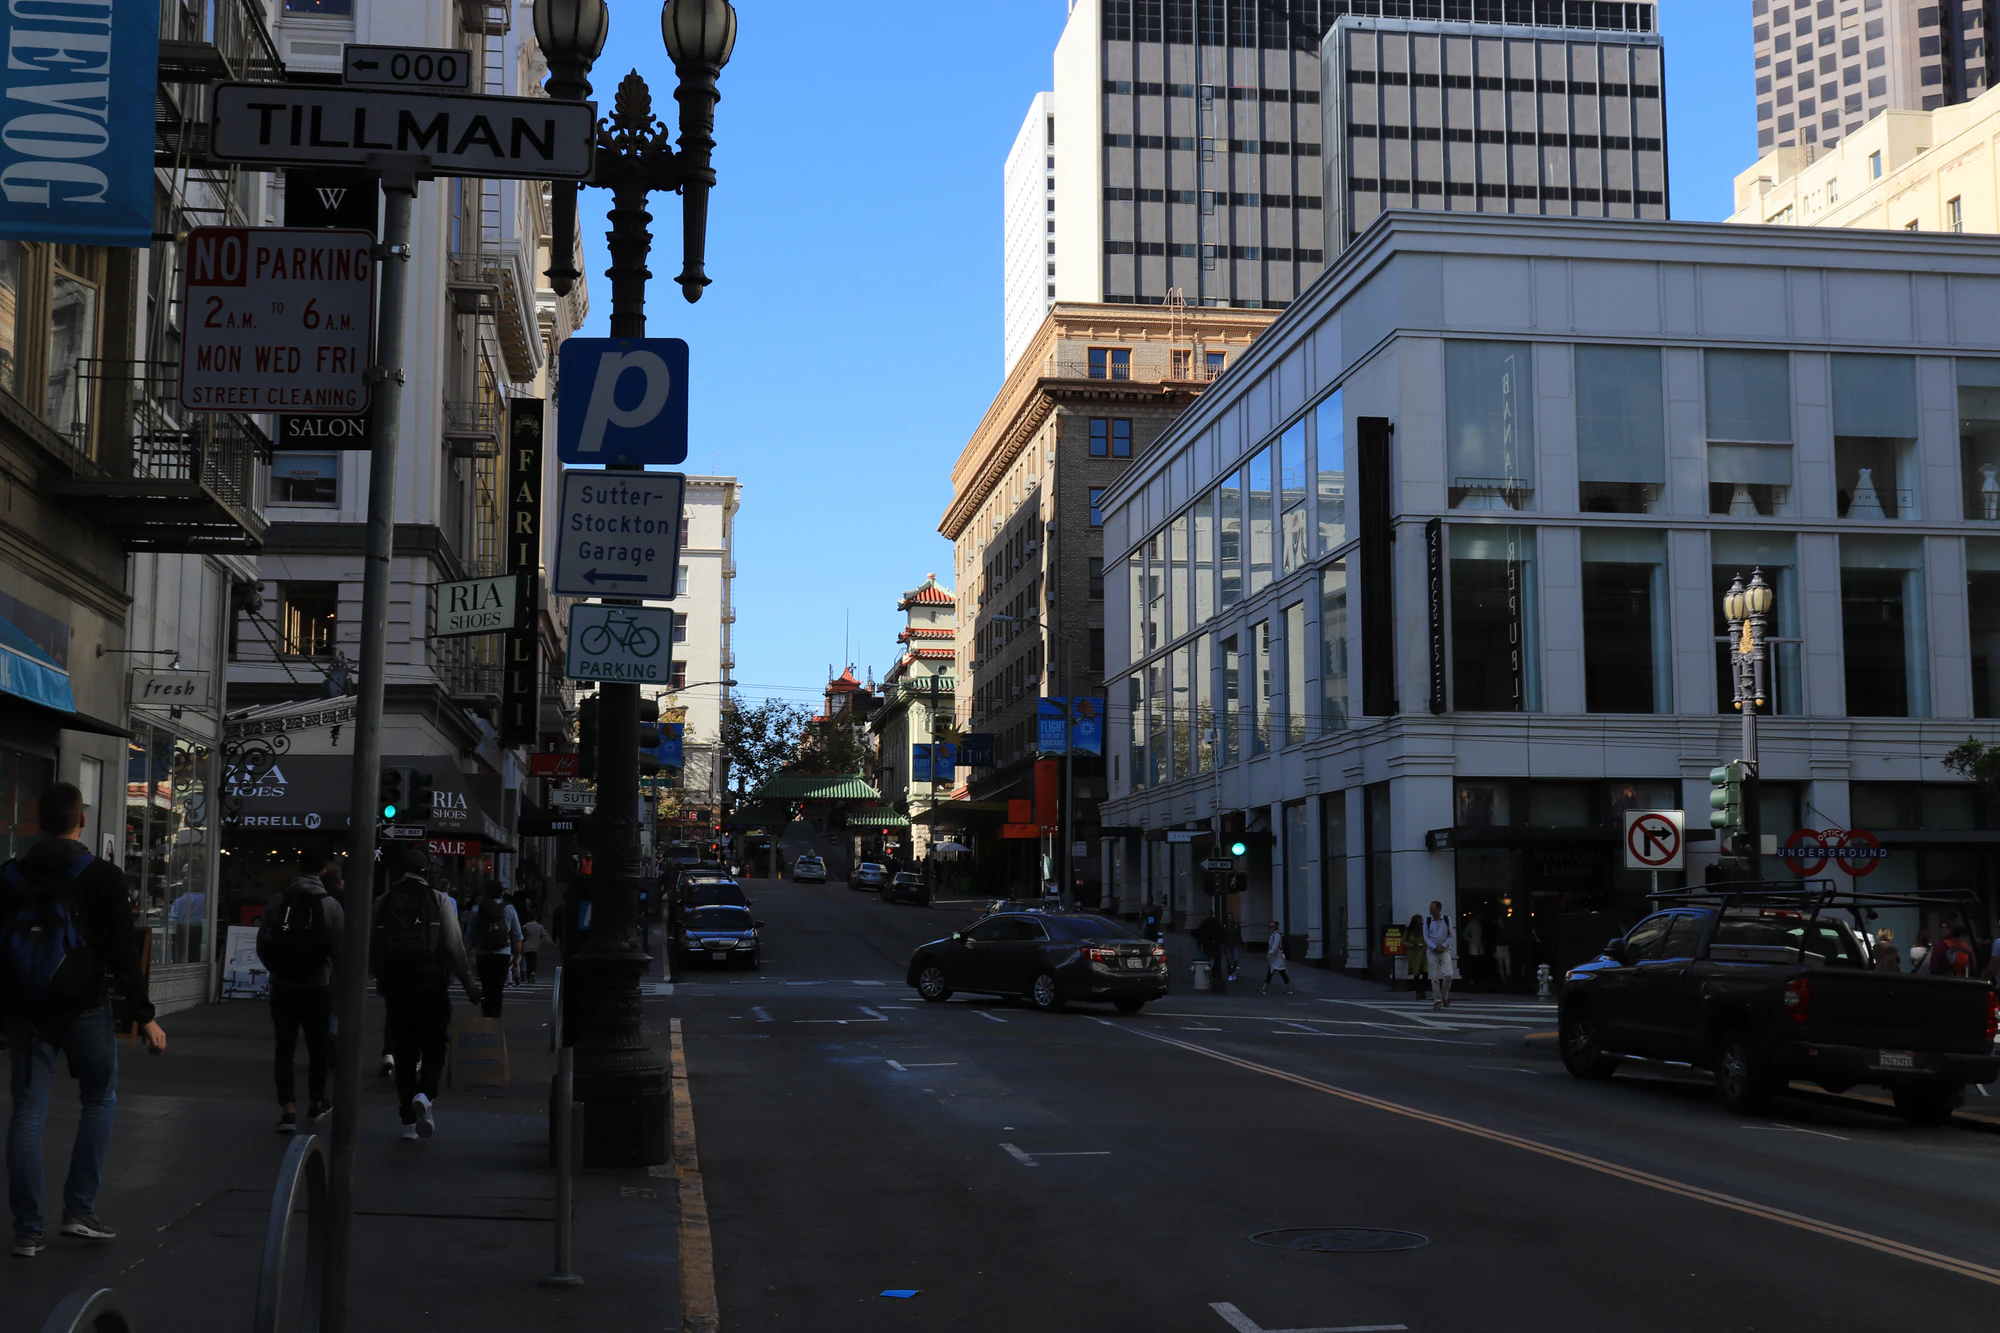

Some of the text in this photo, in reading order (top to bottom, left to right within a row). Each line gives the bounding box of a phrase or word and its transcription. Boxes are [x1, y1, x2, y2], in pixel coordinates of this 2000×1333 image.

[391, 53, 457, 82] 000
[247, 102, 555, 160] TILLMAN
[315, 188, 348, 210] W
[194, 236, 369, 281] NO PARKING
[204, 295, 355, 331] 2 A.M. TO 6 A.M.
[197, 345, 356, 373] MON WED FRI
[192, 386, 357, 407] STREET CLEANING
[289, 419, 365, 438] SALON
[581, 485, 664, 506] Sutter-
[571, 514, 669, 535] Stockton
[578, 542, 656, 567] Garage
[449, 582, 504, 613] RIA
[512, 448, 534, 727] FARILLI
[450, 611, 501, 630] SHOES
[580, 660, 657, 679] PARKING
[143, 680, 196, 698] fresh
[1040, 720, 1066, 732] FLIGHT
[431, 790, 468, 809] RIA
[433, 809, 467, 820] SHOES
[551, 822, 573, 830] HOTEL
[1817, 829, 1848, 842] OPTICAL
[429, 840, 466, 855] SALE
[1778, 848, 1888, 858] UNDERGROUND
[1543, 862, 1594, 877] LEATHER
